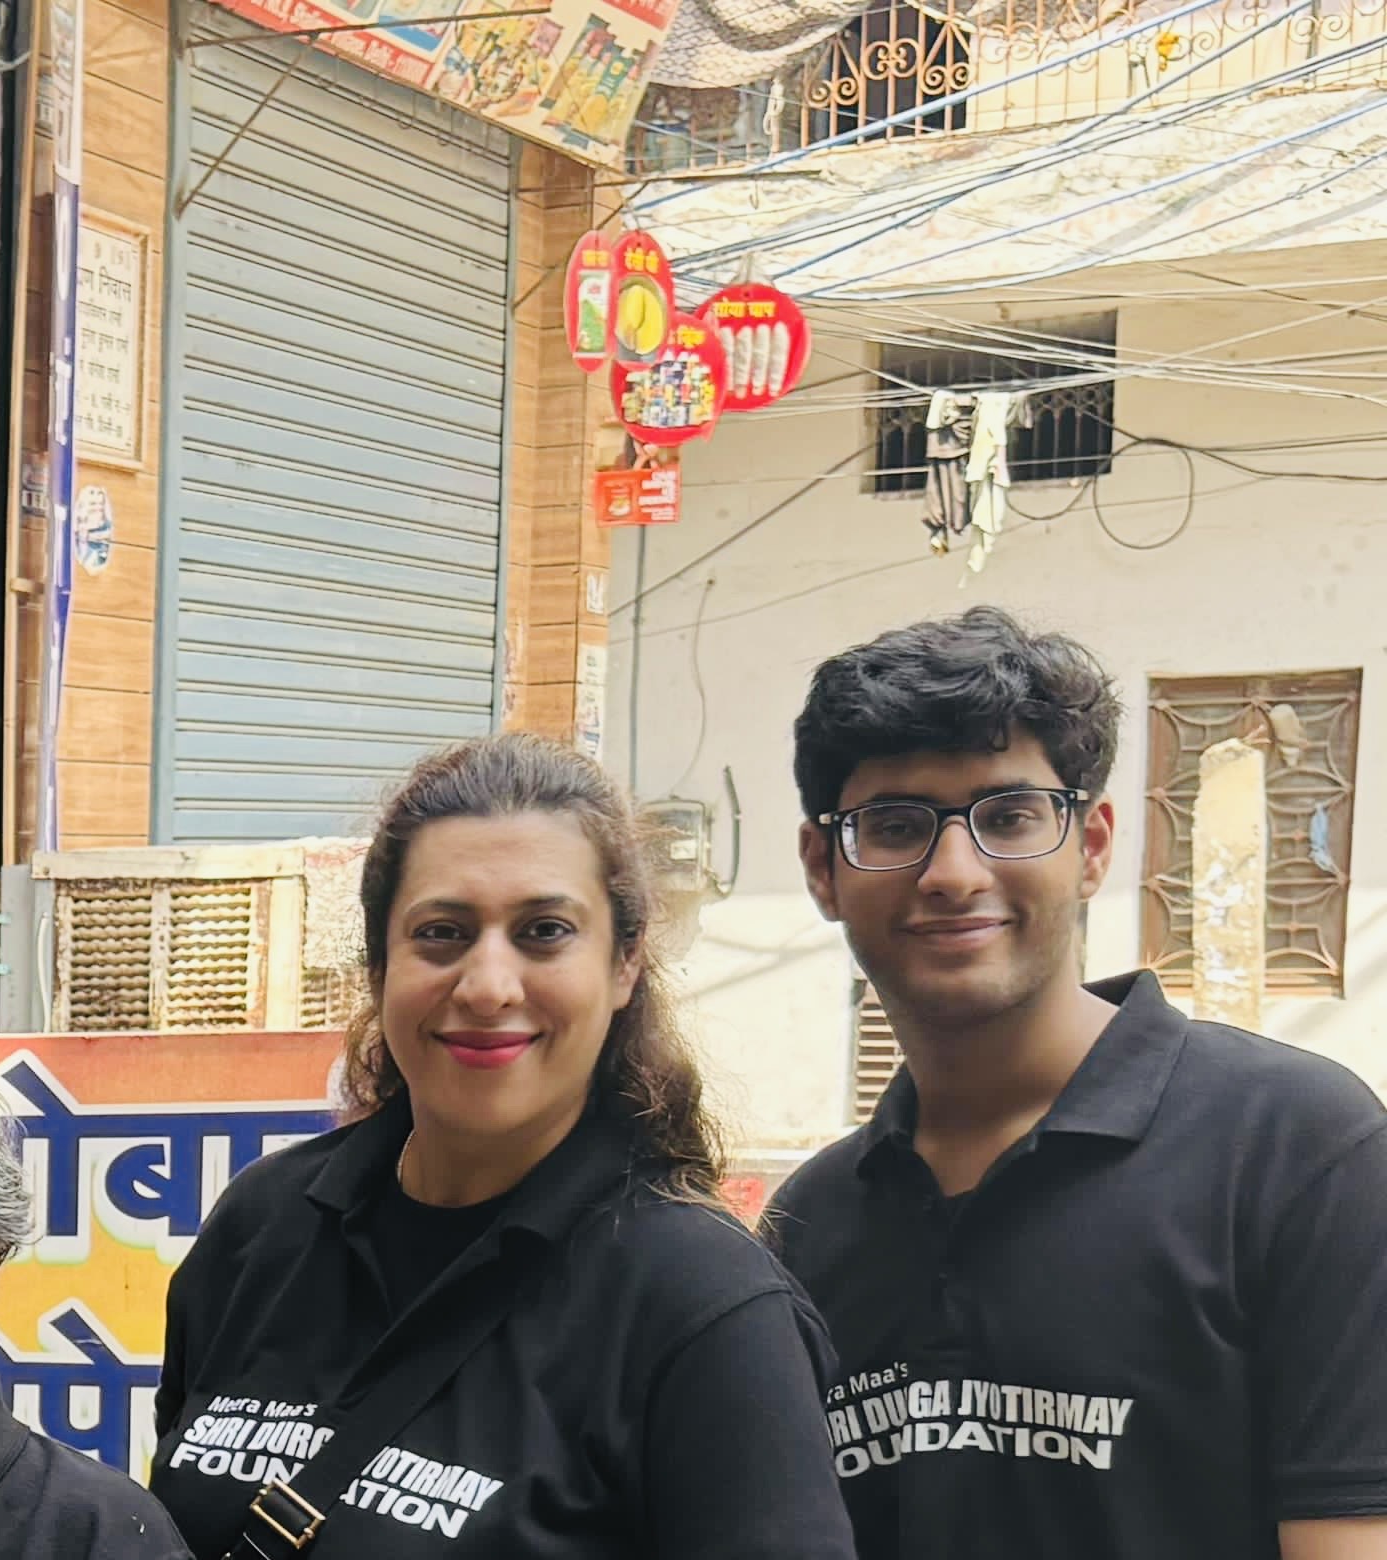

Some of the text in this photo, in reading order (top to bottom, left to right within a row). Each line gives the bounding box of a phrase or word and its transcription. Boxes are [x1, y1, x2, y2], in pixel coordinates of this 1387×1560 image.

[848, 1361, 909, 1397] Maa's
[207, 1395, 319, 1418] Meera Maa's
[957, 1379, 1134, 1436] JYOTIRMAY
[184, 1414, 250, 1450] SHRI
[835, 1420, 1113, 1478] OUNDATION
